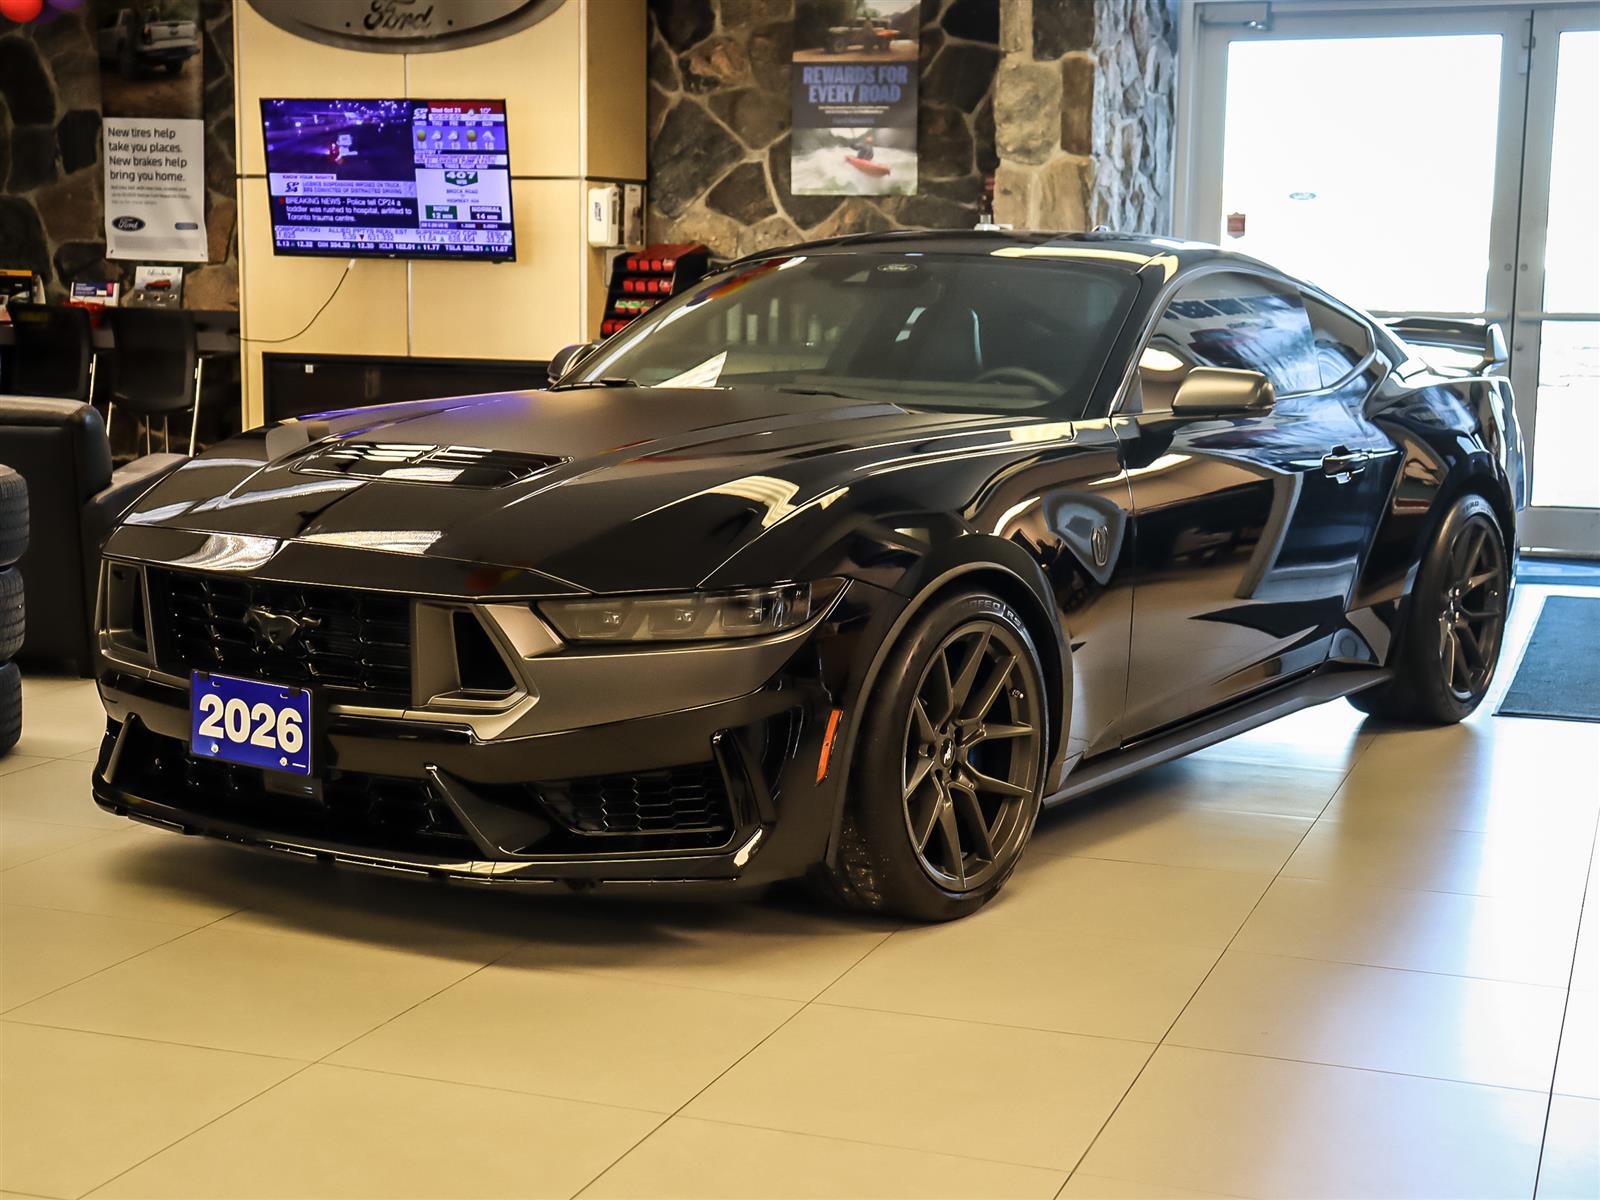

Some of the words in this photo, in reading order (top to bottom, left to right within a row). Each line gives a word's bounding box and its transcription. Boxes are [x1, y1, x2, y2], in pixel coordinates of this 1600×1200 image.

[363, 0, 434, 30] Ford
[803, 66, 875, 84] REWARDS
[878, 66, 907, 84] FOR
[808, 84, 856, 103] EVERY
[859, 84, 901, 102] ROAD
[108, 127, 130, 137] New
[131, 128, 151, 138] tires
[153, 128, 176, 139] help
[108, 142, 129, 151] take
[131, 144, 147, 153] you
[150, 143, 183, 153] places.
[109, 156, 131, 165] New
[133, 156, 162, 167] brakes
[164, 157, 187, 168] help
[109, 170, 135, 181] bring
[137, 173, 153, 182] you
[155, 171, 185, 181] home.
[446, 171, 476, 179] 407
[285, 197, 320, 205] BREAKING
[321, 197, 341, 205] NEWS
[346, 198, 366, 206] Police
[286, 205, 308, 213] toddler
[323, 206, 344, 214] rushed
[287, 213, 311, 221] Toronto
[311, 213, 334, 221] trauma
[118, 218, 139, 229] Ford
[199, 694, 303, 753] 2026
